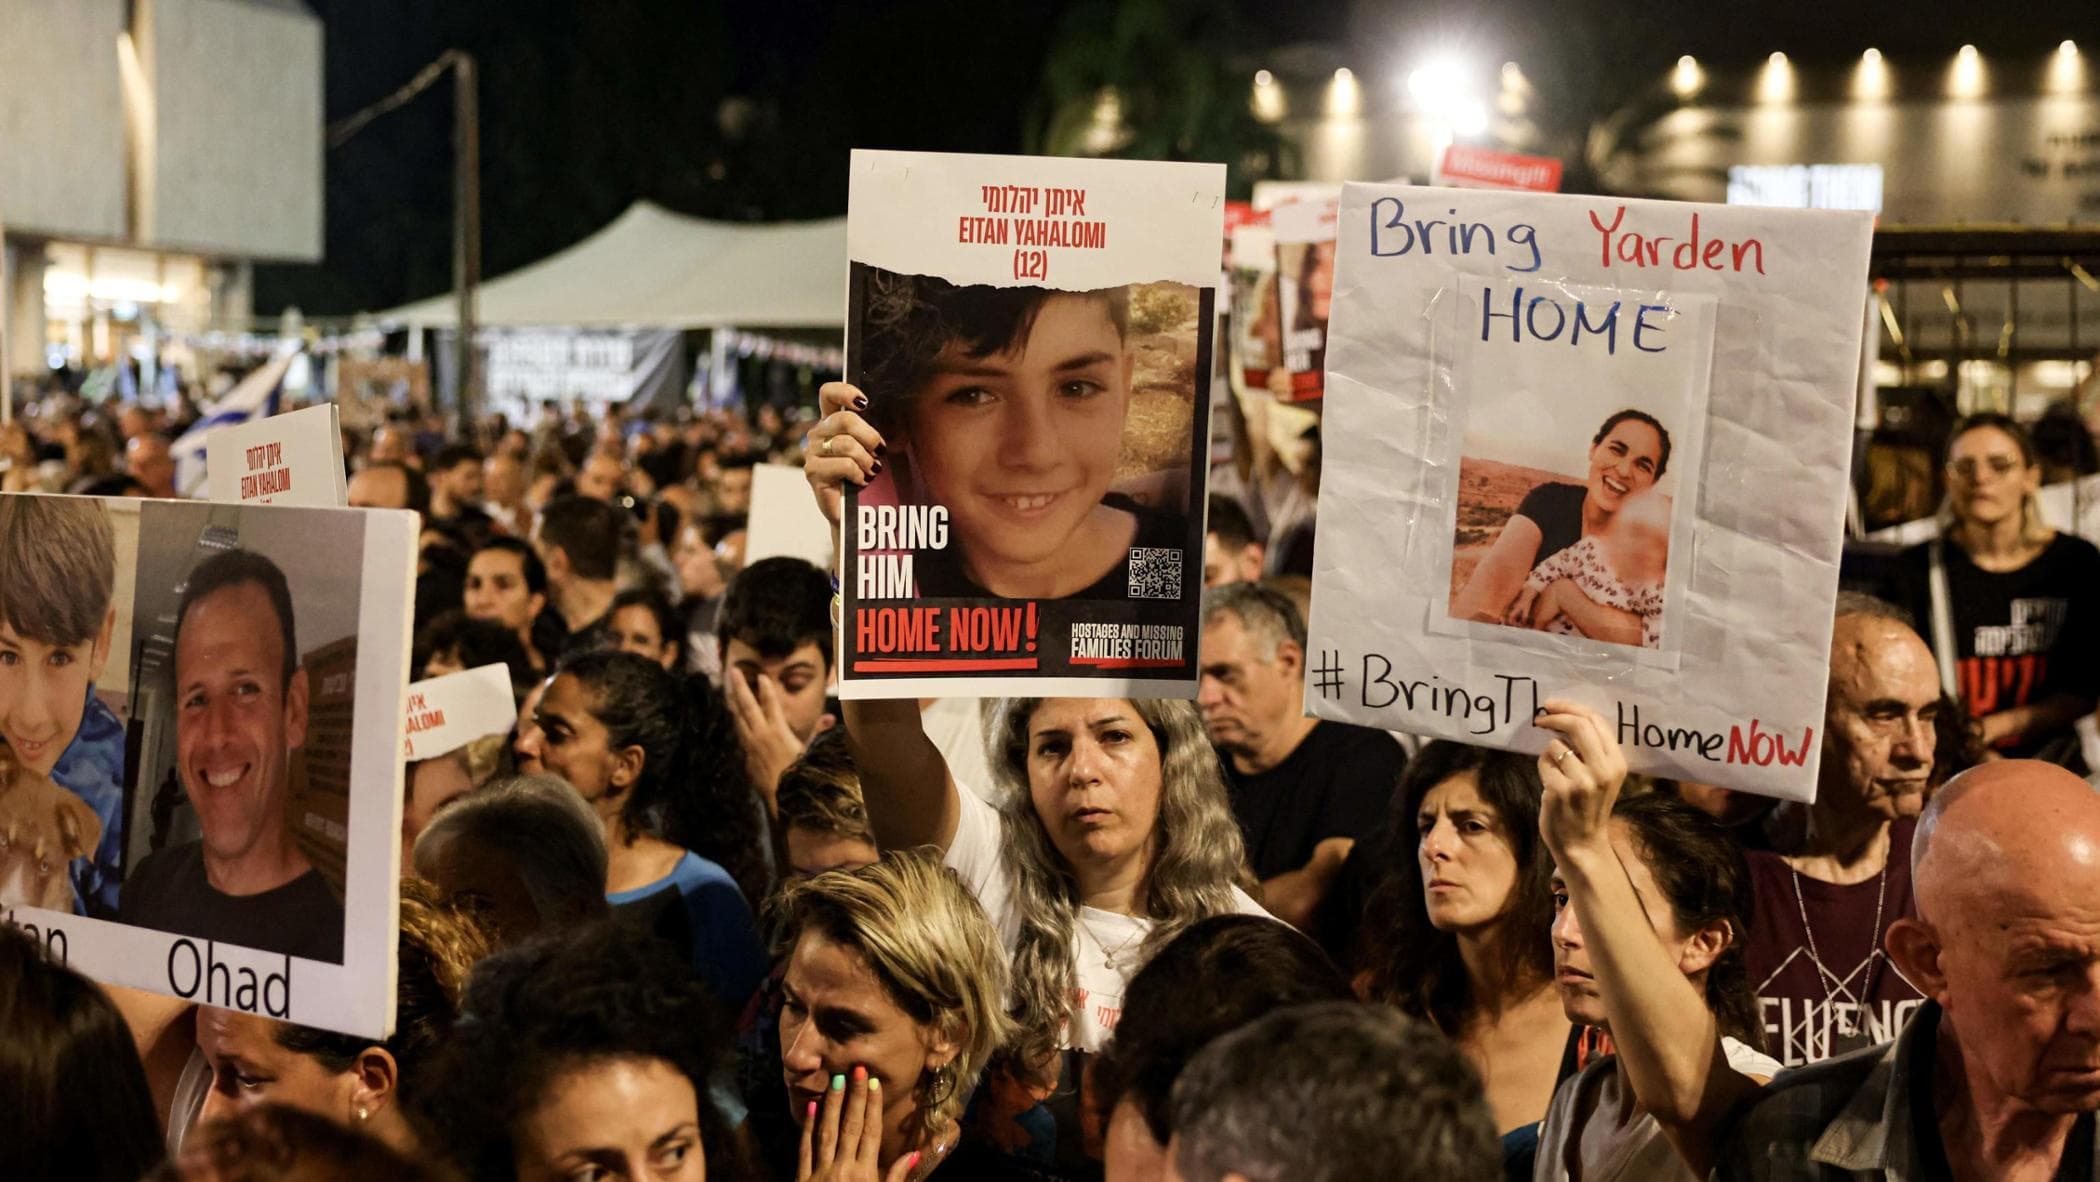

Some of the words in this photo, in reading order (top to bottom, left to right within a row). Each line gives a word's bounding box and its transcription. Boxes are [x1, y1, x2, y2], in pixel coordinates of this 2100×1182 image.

[982, 185, 1039, 214] יהלומי
[1045, 188, 1086, 218] איתן
[959, 216, 1009, 245] EITAN
[1014, 219, 1106, 249] YAHALOMI
[1370, 196, 1542, 272] Bring
[1589, 206, 1766, 276] Yarden
[1013, 249, 1048, 281] (12)
[1481, 287, 1681, 355] HOME
[241, 475, 257, 500] EITAN
[258, 467, 291, 495] YAHALOMI
[857, 505, 949, 550] BRING
[857, 554, 913, 600] HIM
[857, 607, 941, 653] HOME
[950, 602, 1037, 652] NOW!
[1071, 623, 1120, 639] HOSTAGES
[1121, 624, 1140, 640] AND
[1142, 624, 1184, 640] MISSING
[1071, 638, 1132, 659] FAMILIES
[1135, 639, 1183, 660] FORUM
[168, 938, 291, 1019] Ohad
